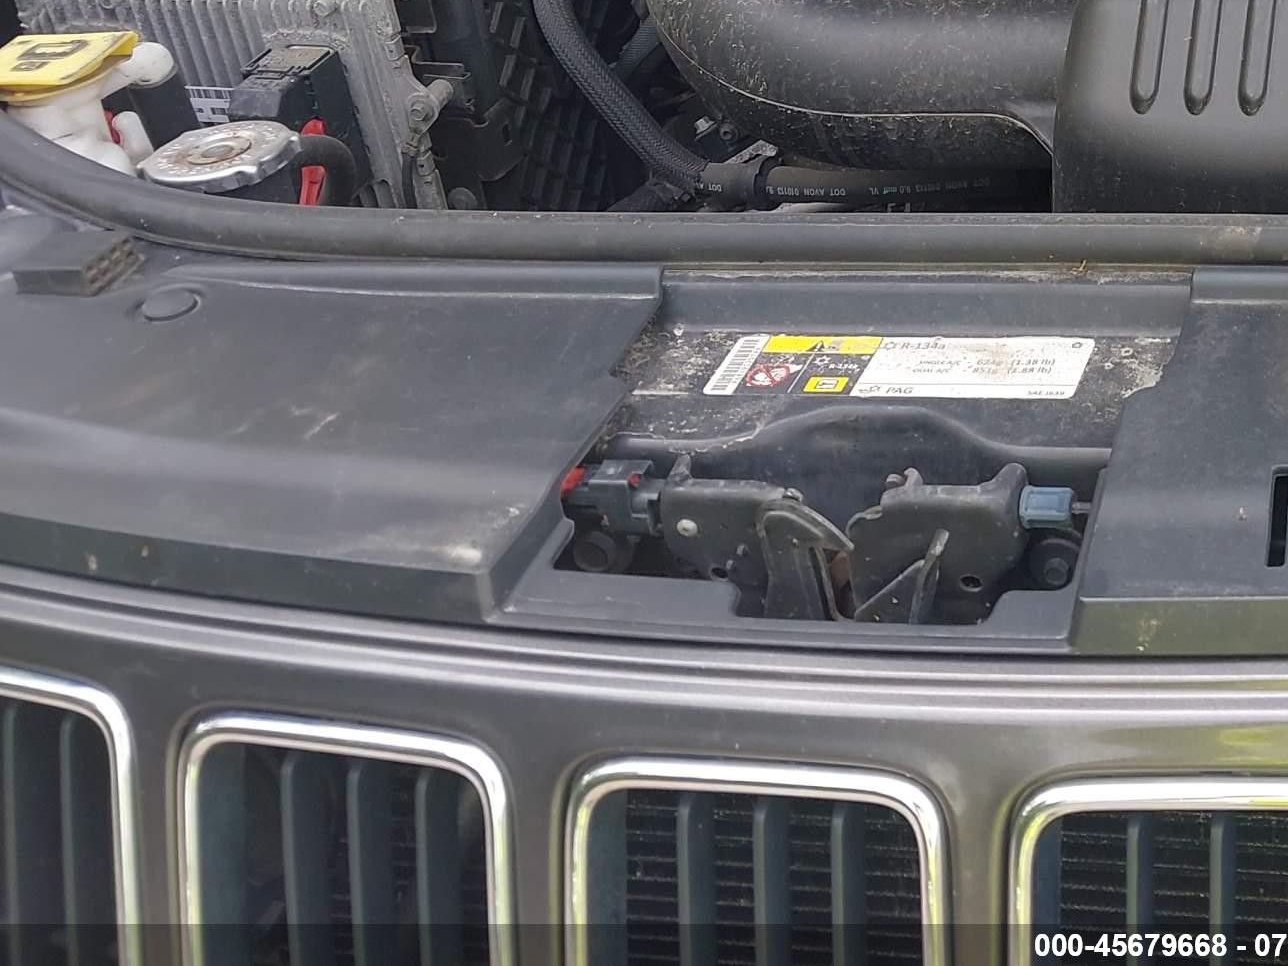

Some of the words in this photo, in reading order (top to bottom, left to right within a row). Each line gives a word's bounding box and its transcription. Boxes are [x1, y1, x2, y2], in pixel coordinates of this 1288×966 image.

[708, 183, 722, 192] DOT
[803, 187, 825, 196] AVON
[829, 188, 846, 196] DOT
[901, 341, 946, 350] R-134a
[886, 387, 915, 395] PAG
